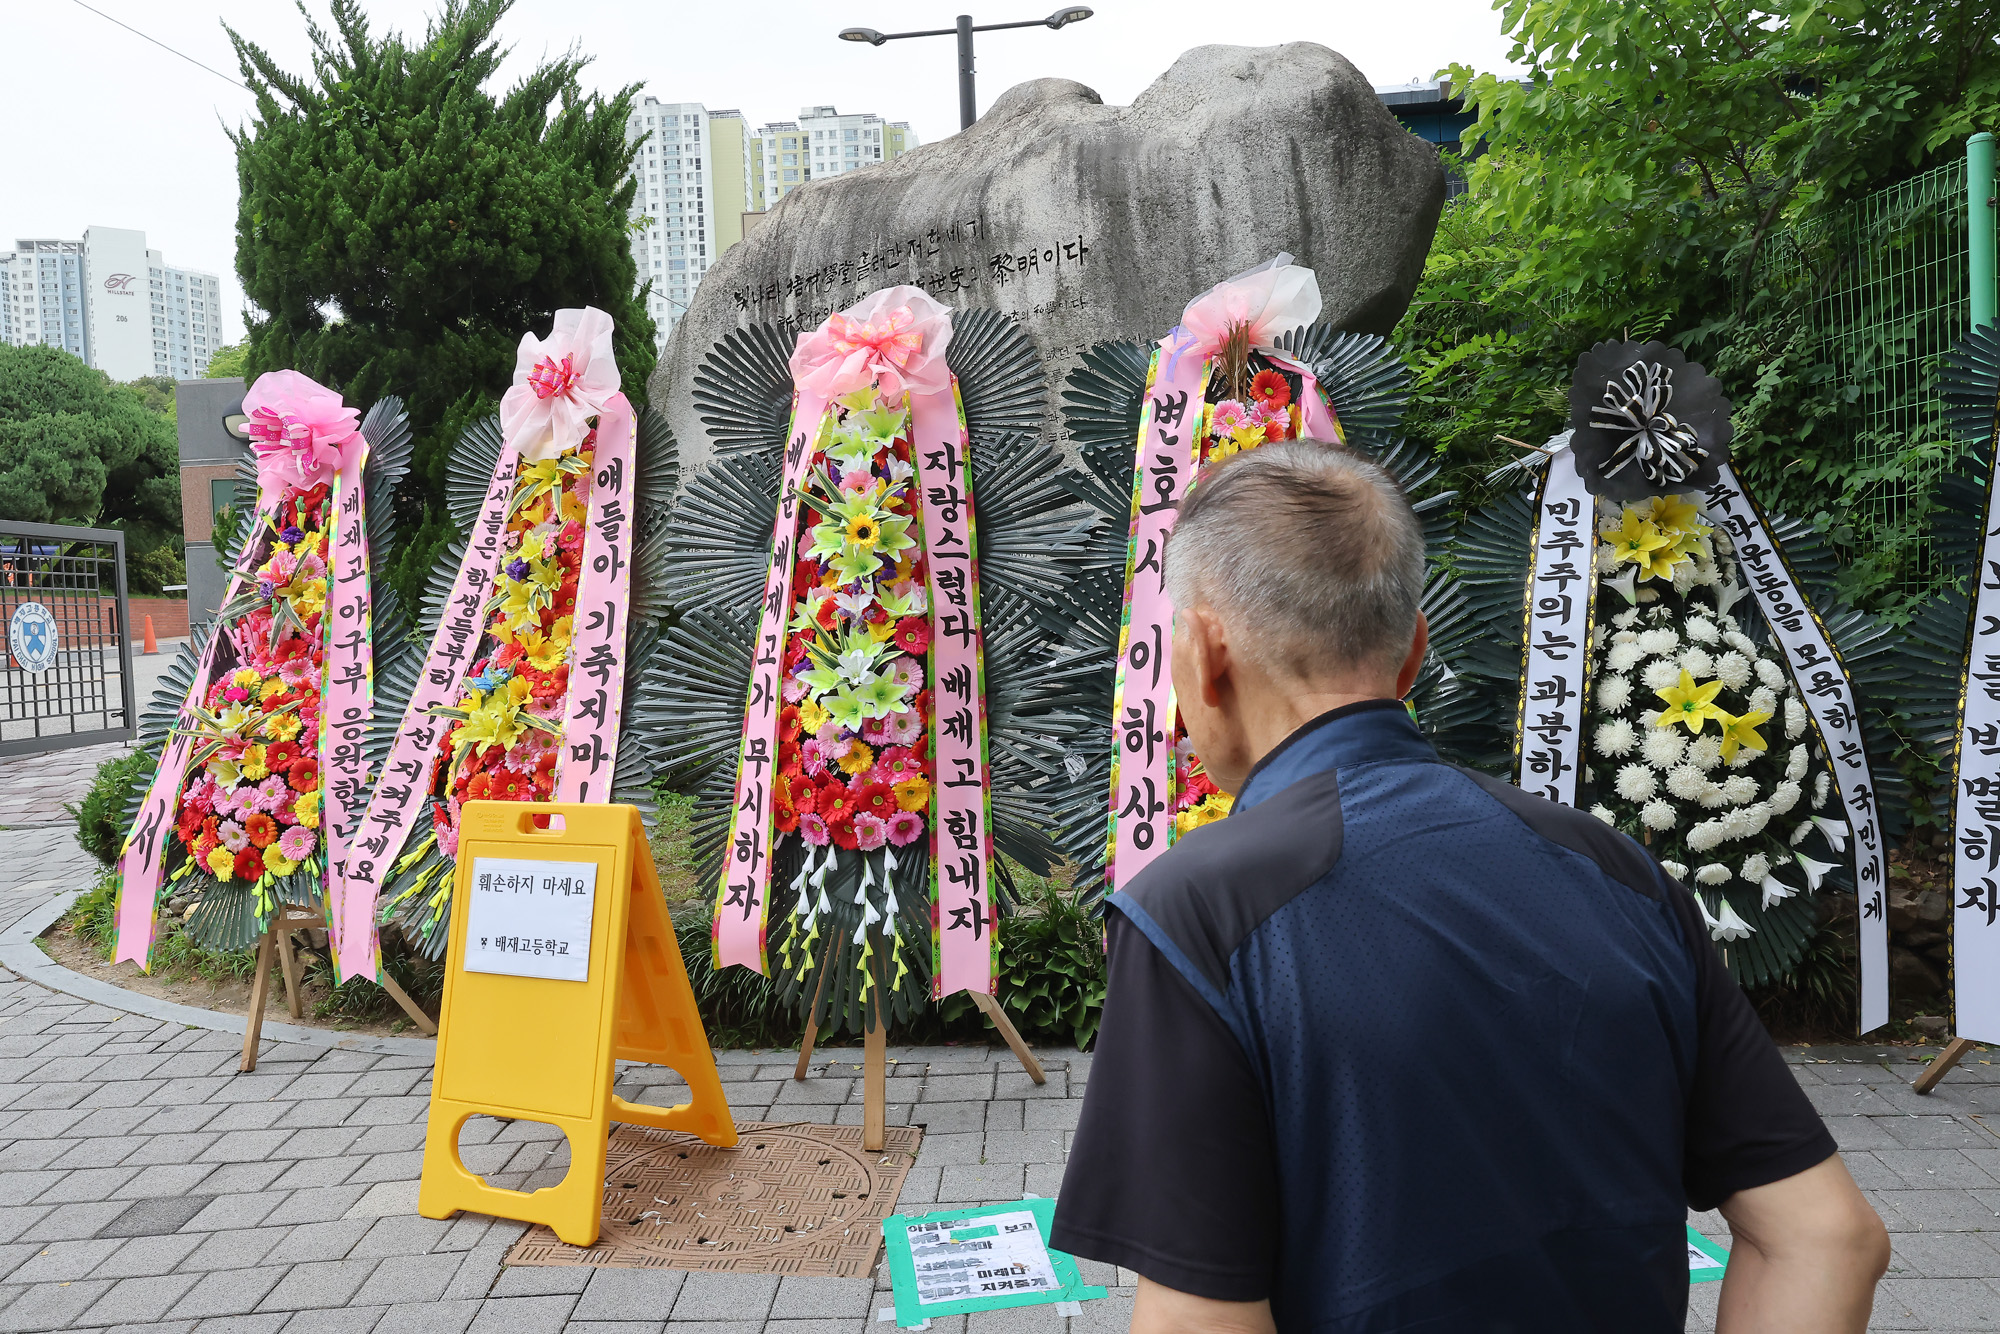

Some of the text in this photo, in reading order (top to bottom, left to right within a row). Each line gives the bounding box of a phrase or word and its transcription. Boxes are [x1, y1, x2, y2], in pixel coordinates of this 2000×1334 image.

[107, 289, 135, 297] HILLSTATE
[337, 487, 367, 584] 배재고
[1533, 497, 1584, 660] 민주주의는
[331, 595, 368, 695] 야구부
[429, 567, 491, 692] 학생들부터
[750, 535, 790, 718] 배재고가
[923, 441, 990, 941] 자랑스럽다 배재고 힘내자
[1117, 624, 1165, 850] 이하상
[348, 759, 423, 884] 지켜주세요
[723, 737, 770, 921] 무시하자
[1848, 783, 1883, 923] 국민에게
[478, 873, 587, 897] 훼손하지 마세요
[495, 936, 569, 956] 배재고등학교
